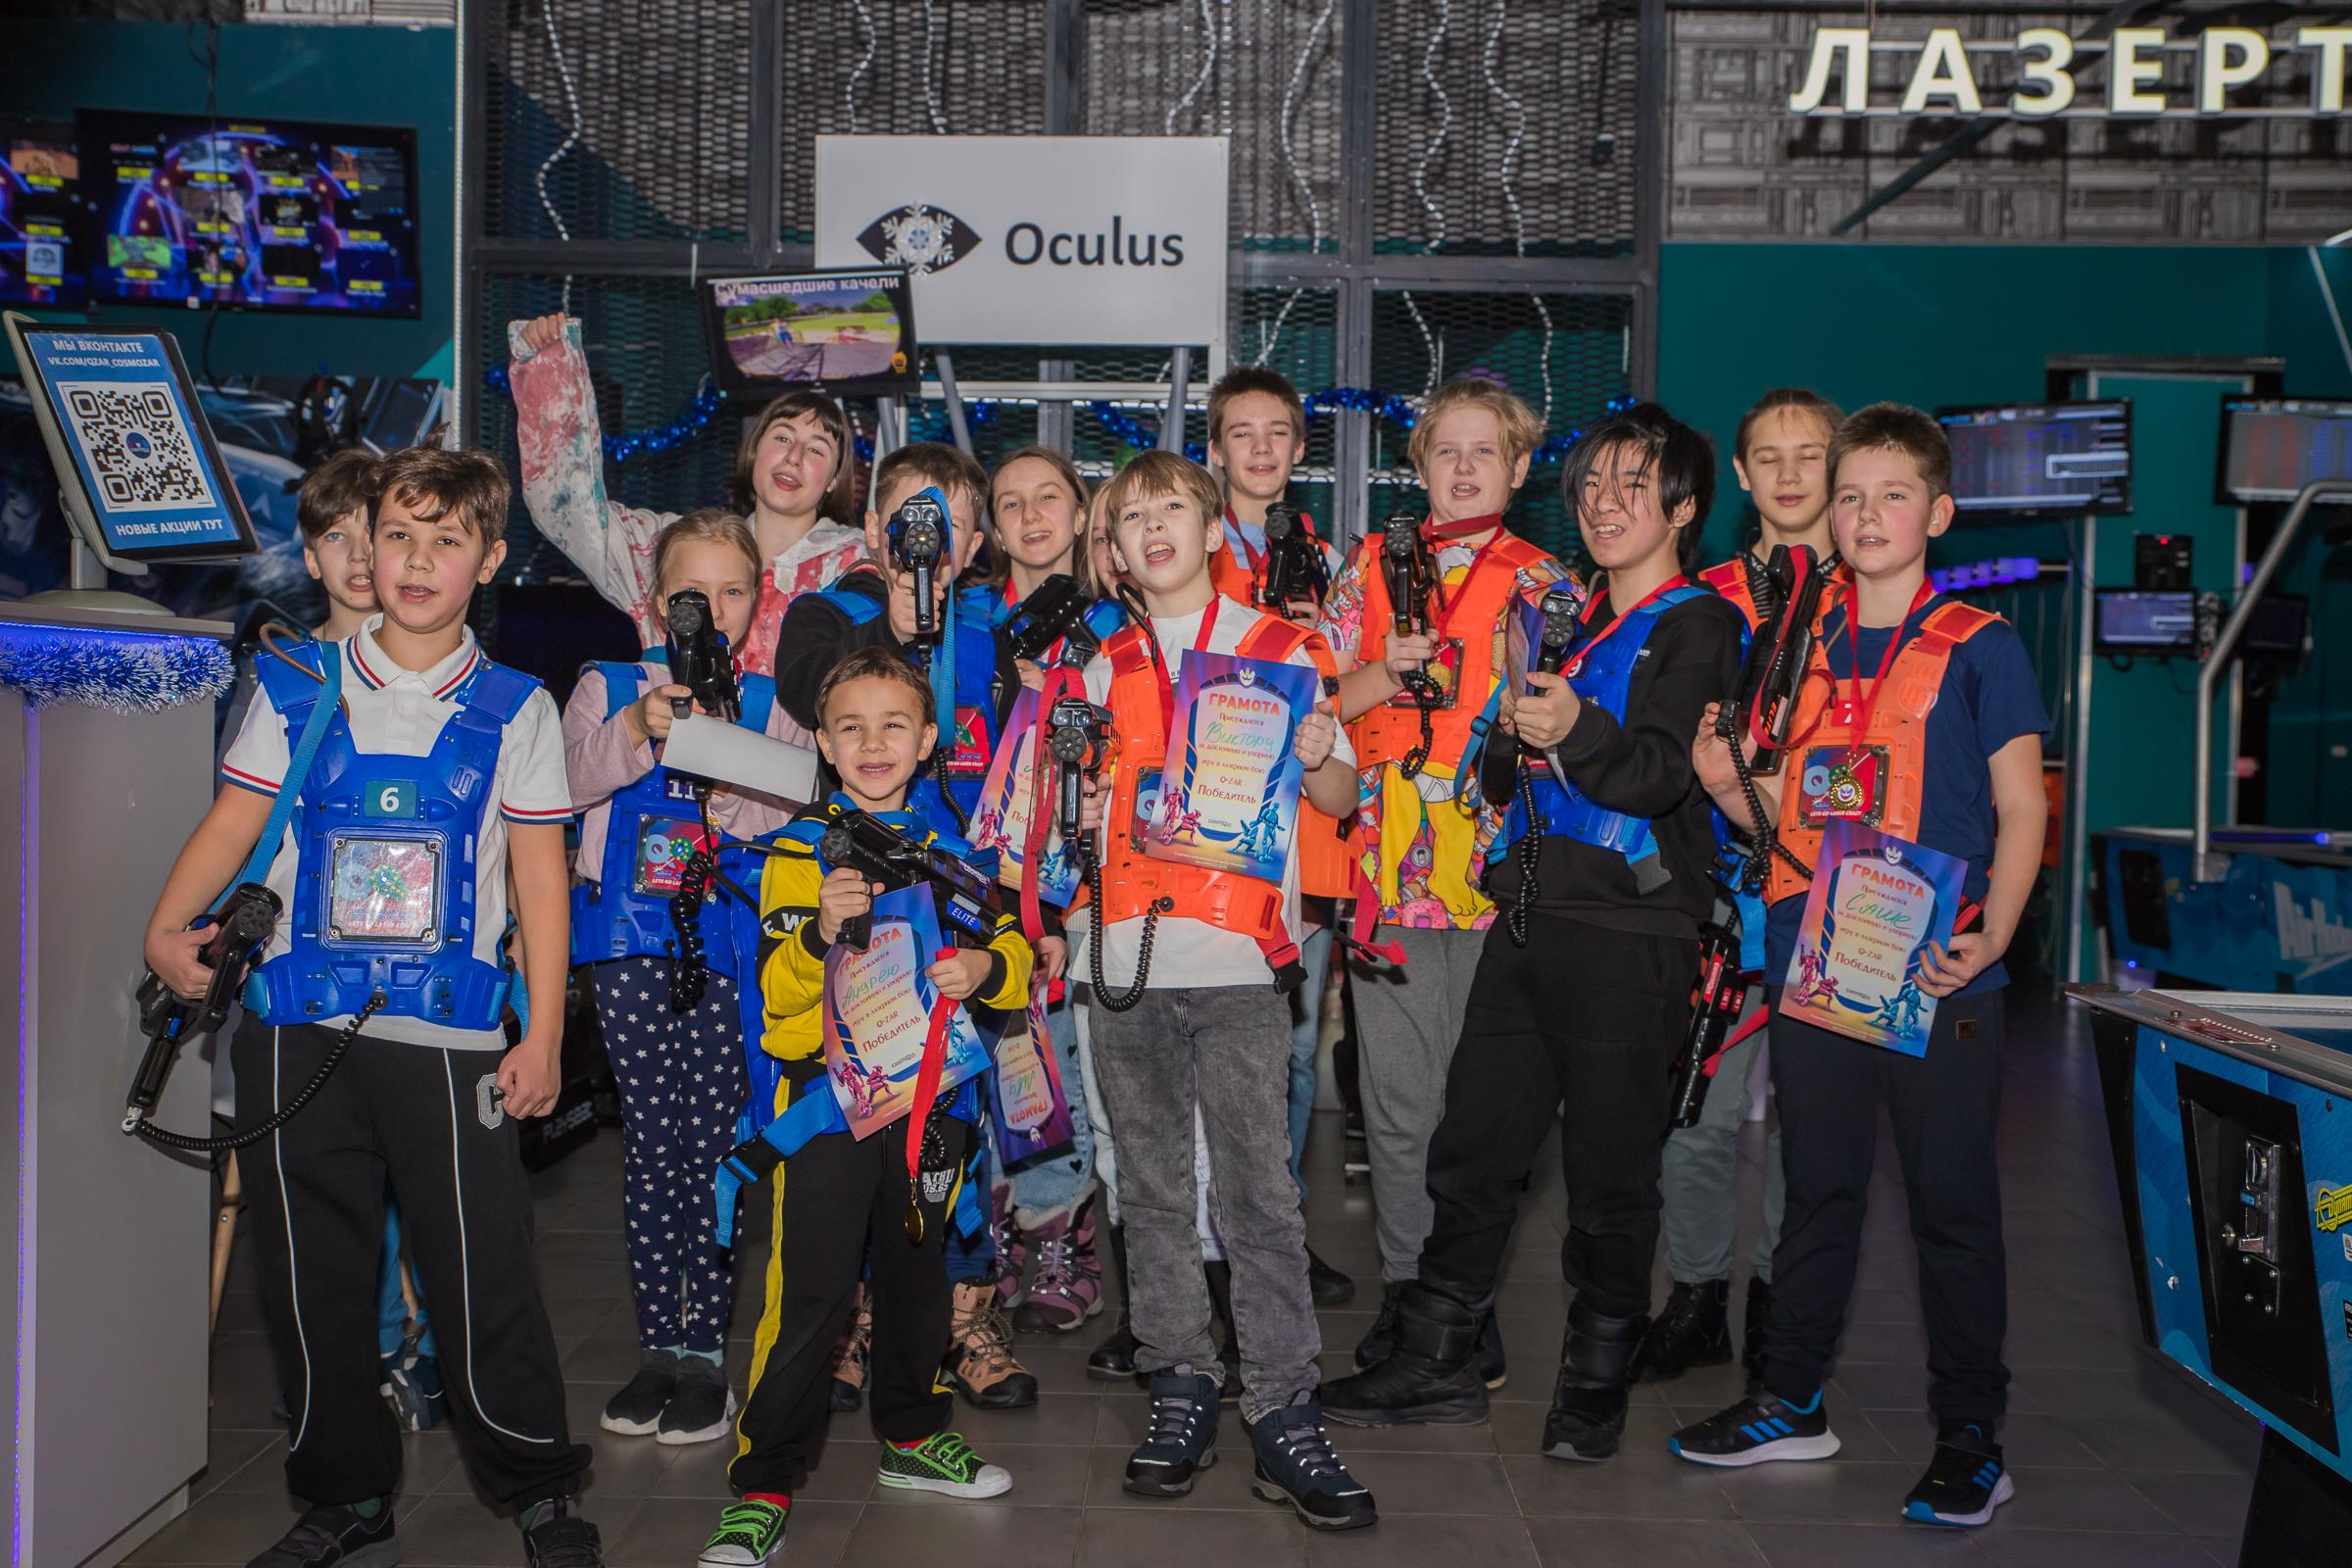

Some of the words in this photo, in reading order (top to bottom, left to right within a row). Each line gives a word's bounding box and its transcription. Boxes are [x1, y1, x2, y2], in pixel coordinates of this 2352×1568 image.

[1789, 26, 2352, 114] ЛАЗЕРТ
[1004, 216, 1184, 267] Oculus
[713, 279, 836, 295] Сумасшедшие
[840, 275, 900, 291] качели
[53, 339, 75, 352] МЫ
[78, 340, 144, 353] ВКОНТАКТЕ
[115, 523, 159, 535] НОВЫЕ
[160, 520, 202, 534] АКЦИИ
[202, 518, 223, 530] ТУТ
[1208, 693, 1280, 715] ГРАМОТА
[379, 787, 400, 812] 6
[1851, 863, 1925, 900] ГРАМОТА
[952, 907, 976, 926] ELITE
[840, 927, 903, 976] ГРАОТА
[1009, 1099, 1049, 1124] ГРАМОТА
